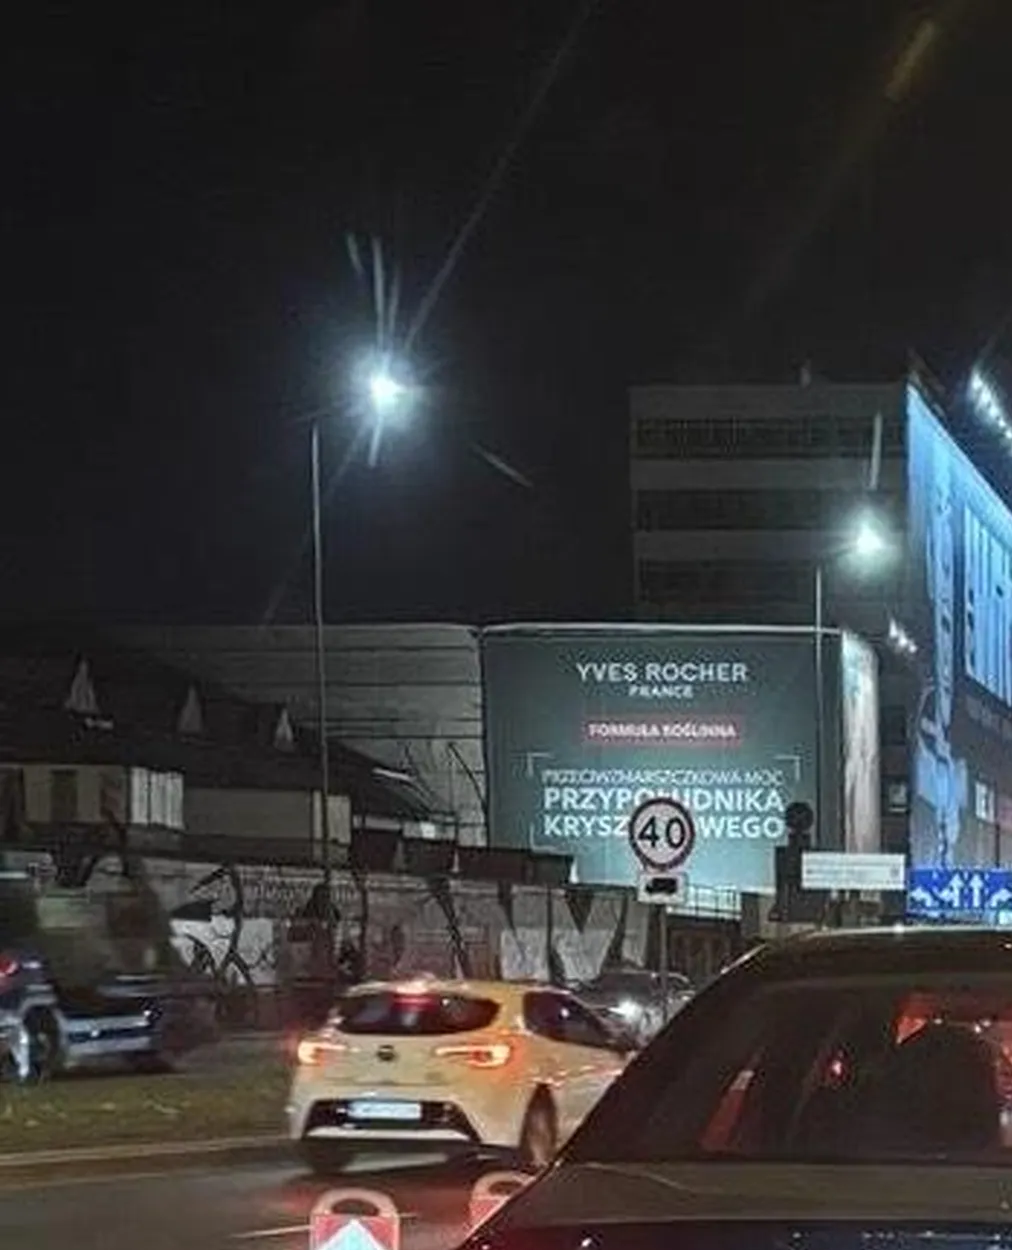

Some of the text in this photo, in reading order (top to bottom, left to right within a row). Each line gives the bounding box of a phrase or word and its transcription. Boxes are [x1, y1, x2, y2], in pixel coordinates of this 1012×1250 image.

[576, 663, 748, 682] YVES ROCHER
[628, 685, 694, 698] FRANCE
[637, 817, 687, 849] 40
